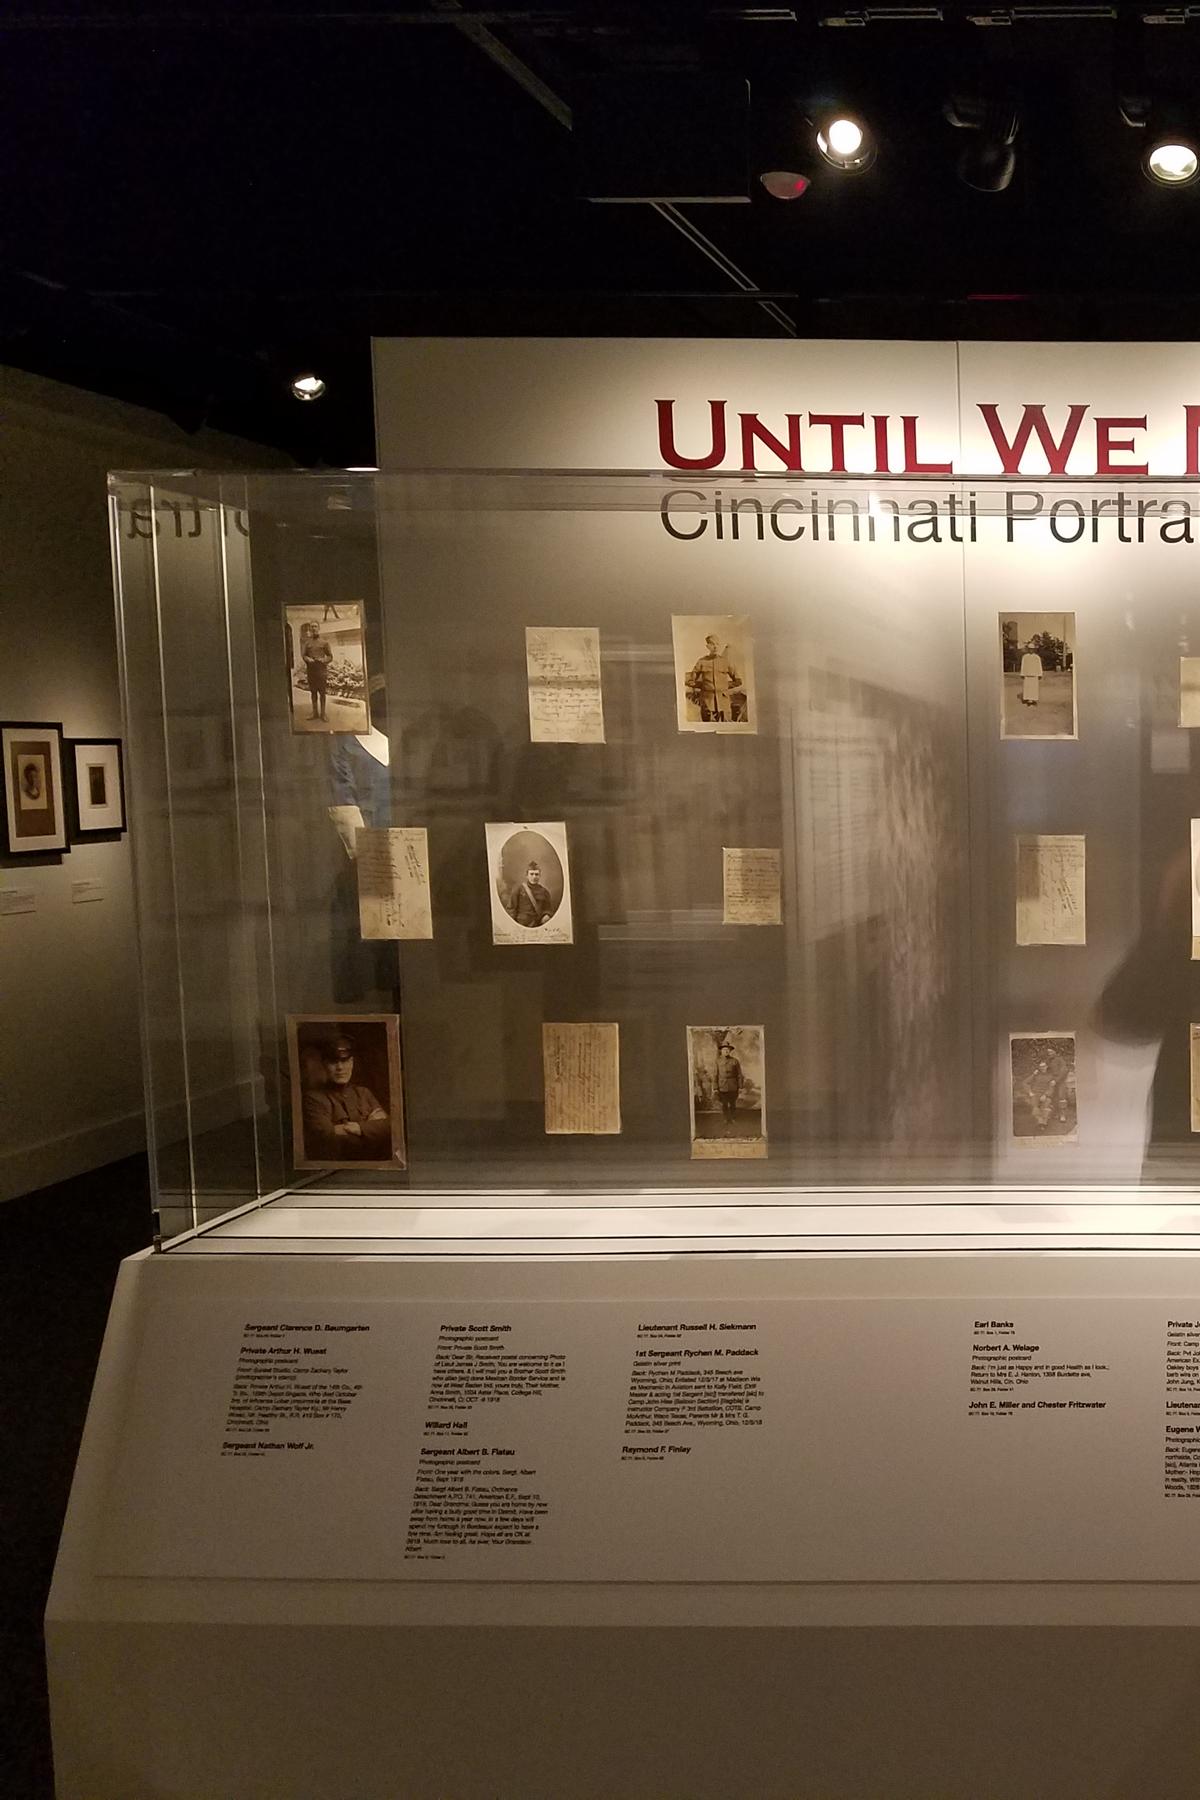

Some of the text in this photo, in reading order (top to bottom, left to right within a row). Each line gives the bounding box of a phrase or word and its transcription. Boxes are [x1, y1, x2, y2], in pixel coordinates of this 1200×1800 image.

[654, 399, 953, 472] UNTIL
[975, 403, 1149, 476] WE
[660, 488, 979, 543] Cincinnati
[244, 1324, 278, 1333] Sergeant
[279, 1324, 312, 1332] Clarence
[324, 1324, 370, 1333] Baumgarten
[679, 1323, 707, 1331] Russell
[240, 1347, 267, 1355] Private
[268, 1347, 292, 1355] Arthur
[973, 1344, 1001, 1352] Norbert
[1012, 1344, 1040, 1353] Welage
[647, 1349, 682, 1358] Sergeant
[968, 1401, 988, 1409] John
[998, 1401, 1020, 1409] Miller
[1021, 1401, 1036, 1409] and
[1037, 1401, 1067, 1409] Chester
[425, 1421, 468, 1429] Willard Hall
[1166, 1426, 1194, 1434] Eugene
[222, 1442, 256, 1450] Sergeant
[622, 1446, 659, 1455] Raymond
[420, 1448, 455, 1457] Sergeant
[456, 1448, 480, 1456] Albert
